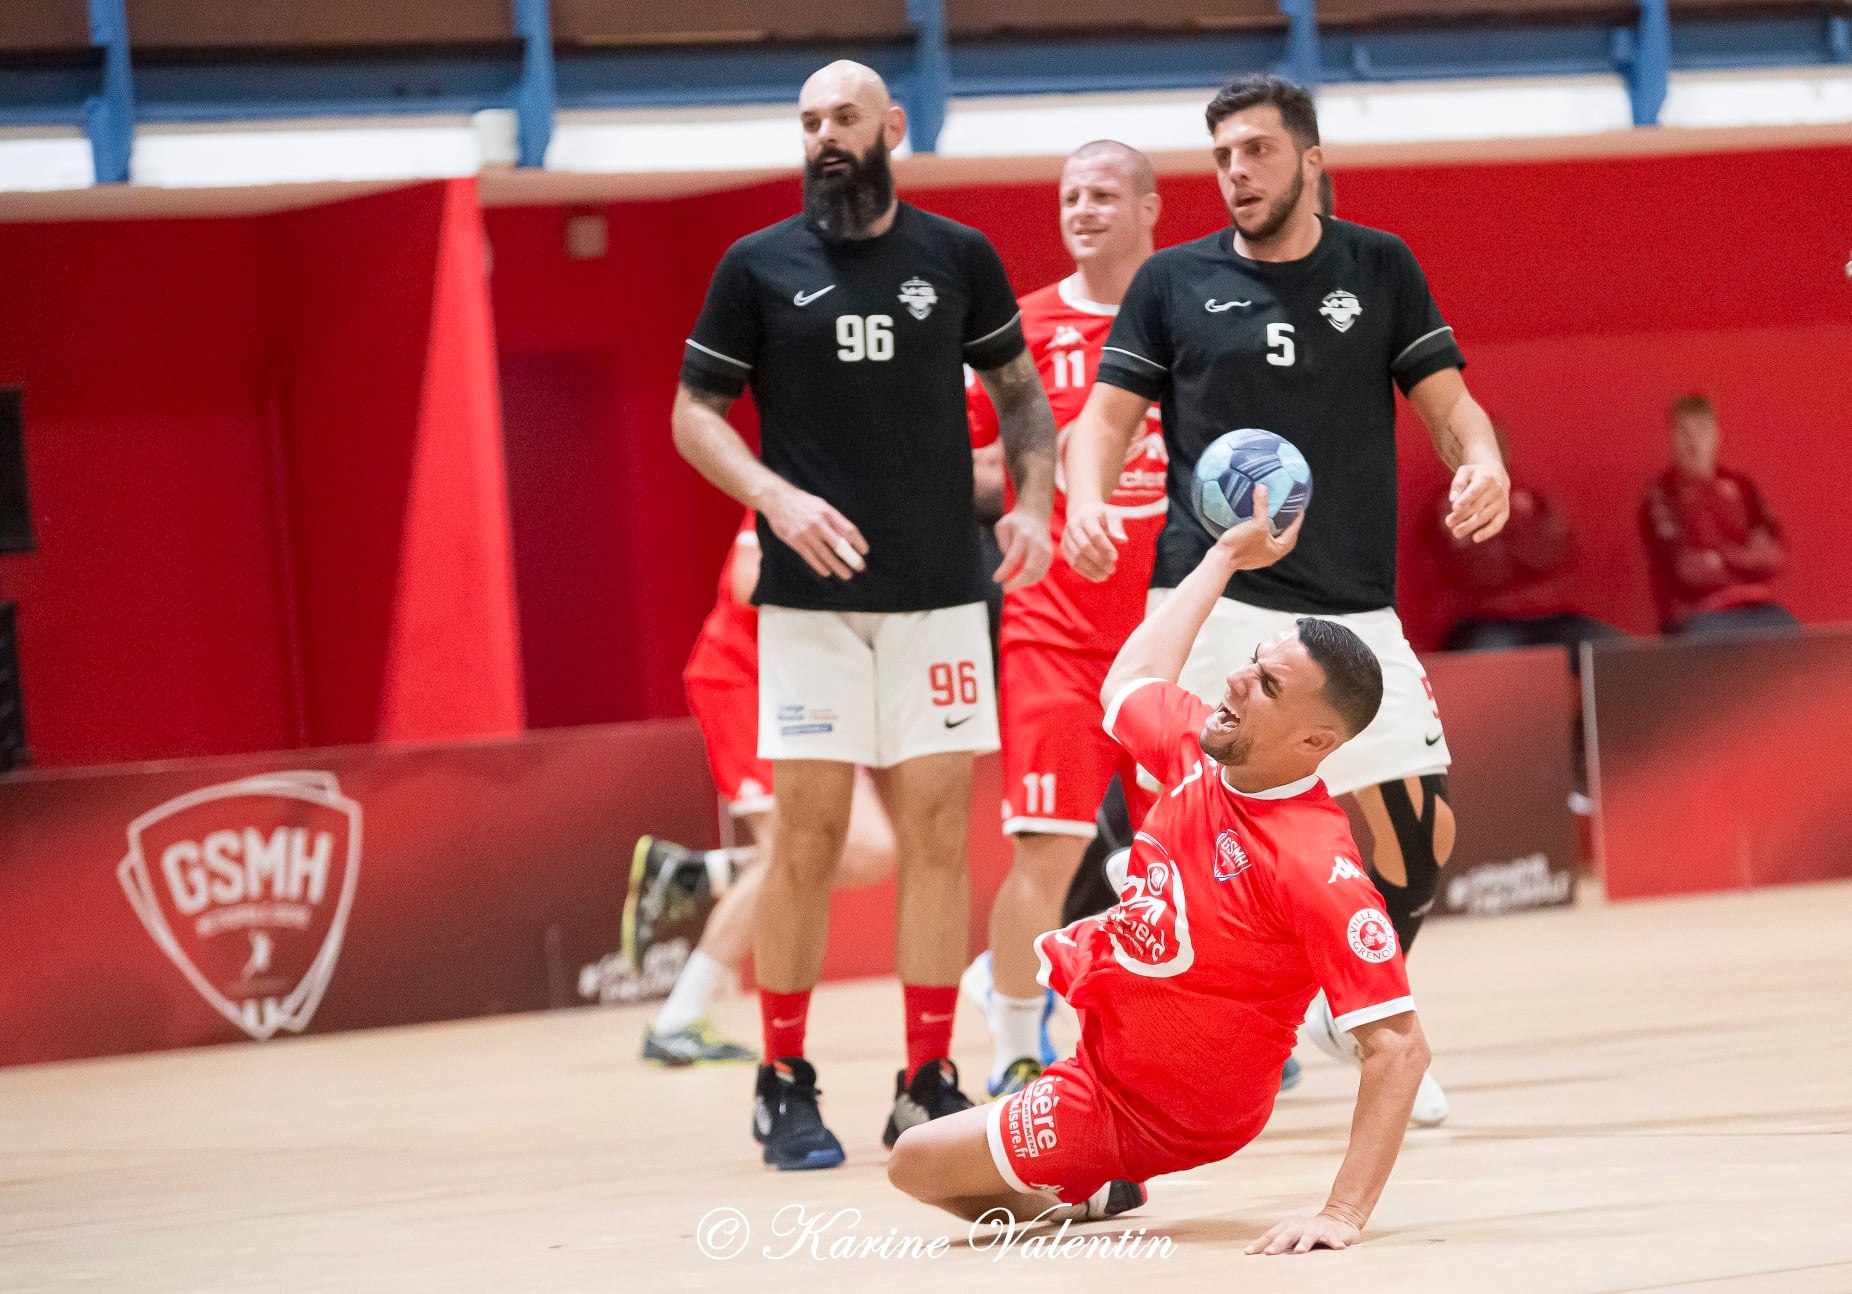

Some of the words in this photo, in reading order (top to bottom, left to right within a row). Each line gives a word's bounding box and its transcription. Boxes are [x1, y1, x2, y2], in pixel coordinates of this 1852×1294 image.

[836, 314, 894, 362] 96
[1266, 322, 1296, 367] 5
[1052, 349, 1086, 389] 11
[929, 660, 979, 706] 96
[1023, 771, 1056, 814] 11
[160, 825, 334, 916] GSMH
[1220, 836, 1249, 868] GSMH
[1349, 911, 1374, 934] VILLE
